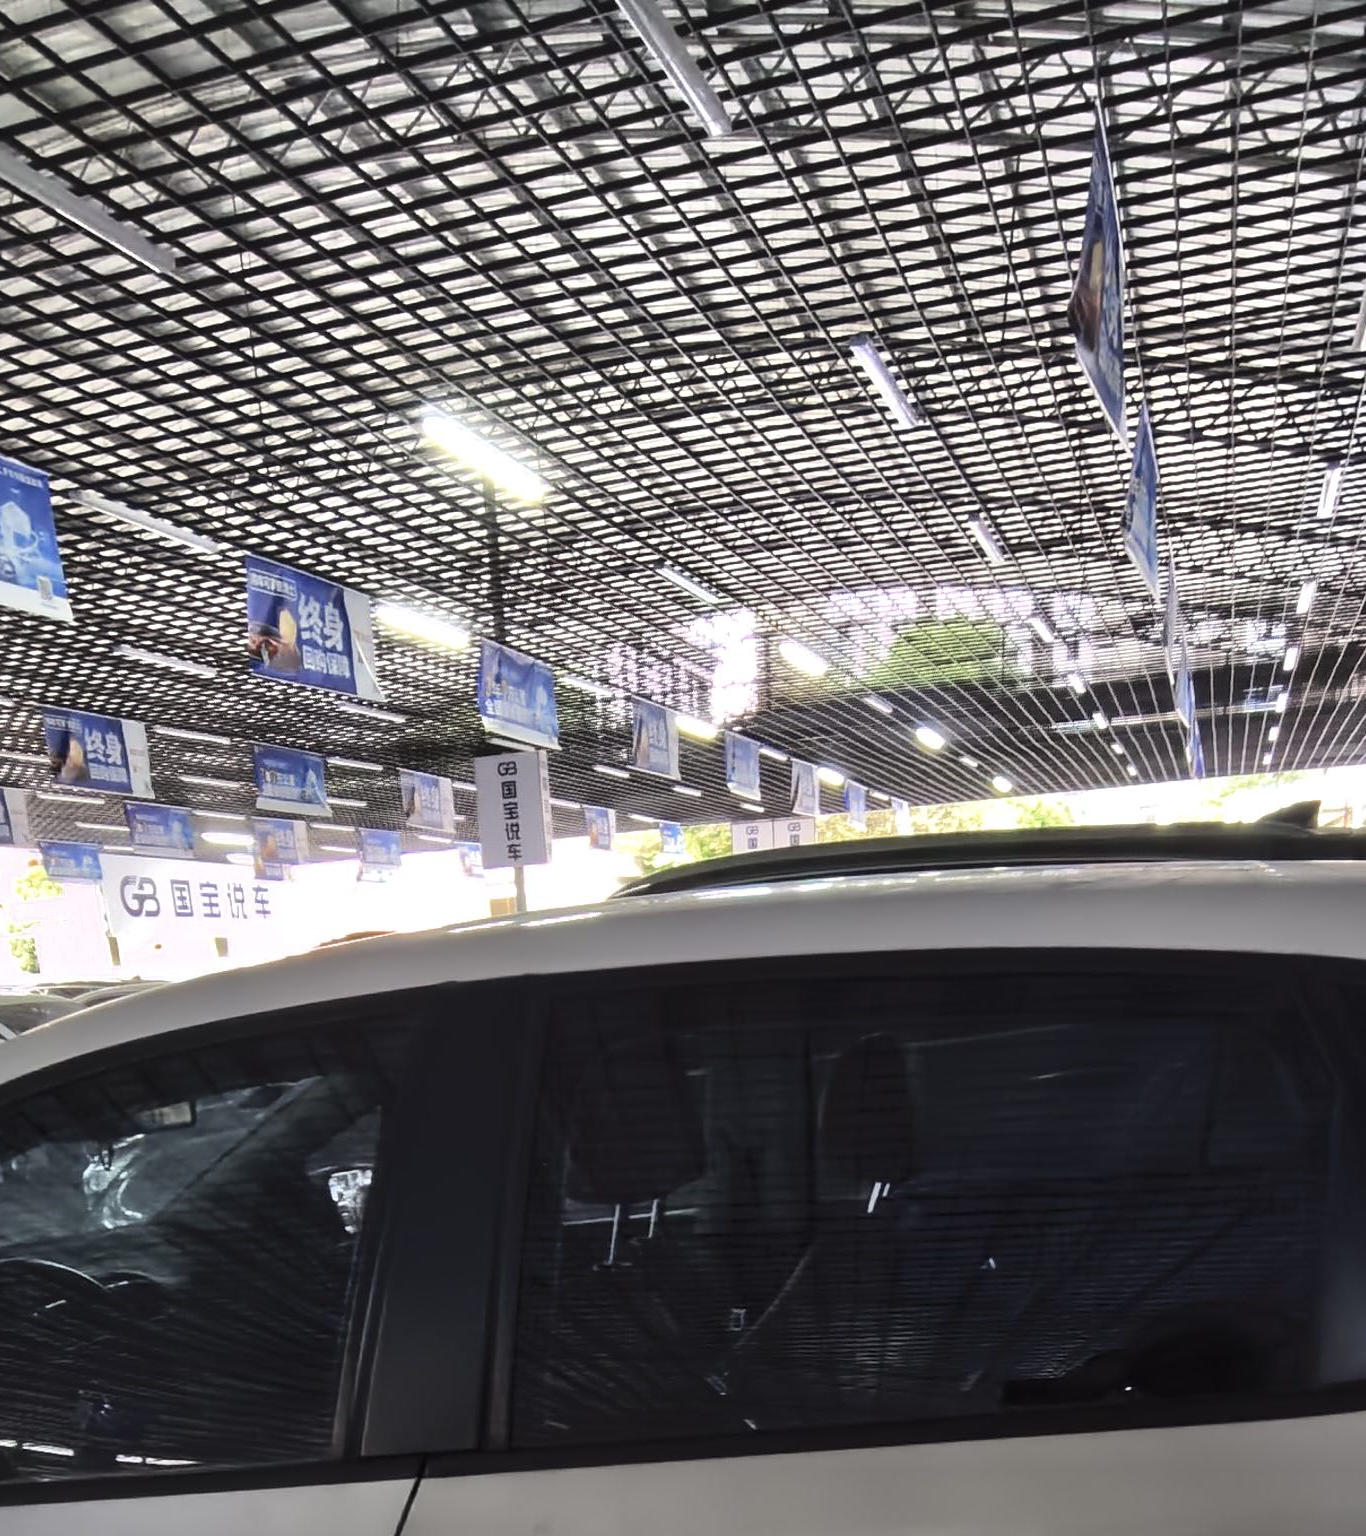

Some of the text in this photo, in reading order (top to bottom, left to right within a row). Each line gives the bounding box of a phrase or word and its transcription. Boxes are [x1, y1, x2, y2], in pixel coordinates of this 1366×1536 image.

[298, 592, 344, 651] 终身
[501, 780, 522, 861] 国宝说车
[170, 879, 271, 919] 国宝说车
